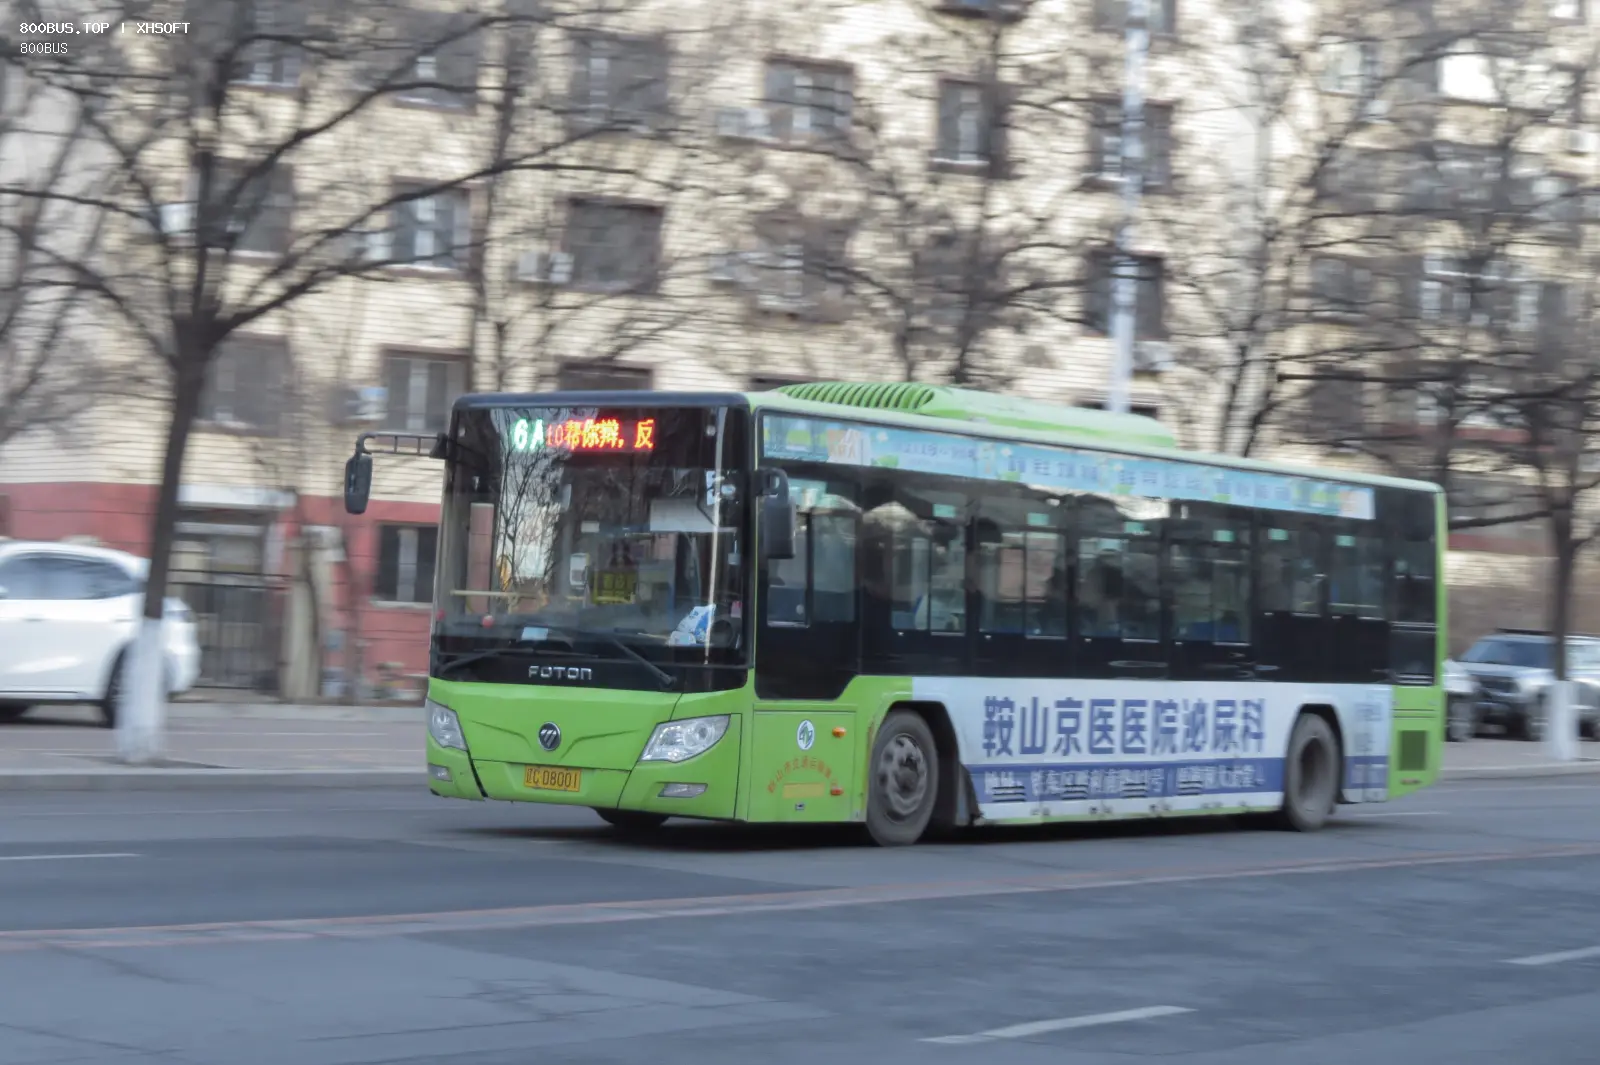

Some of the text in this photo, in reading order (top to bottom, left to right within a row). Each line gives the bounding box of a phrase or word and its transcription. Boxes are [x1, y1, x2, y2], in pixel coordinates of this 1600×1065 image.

[528, 665, 592, 680] FOTON
[982, 695, 1263, 757] 鞍山京医医院泌尿科
